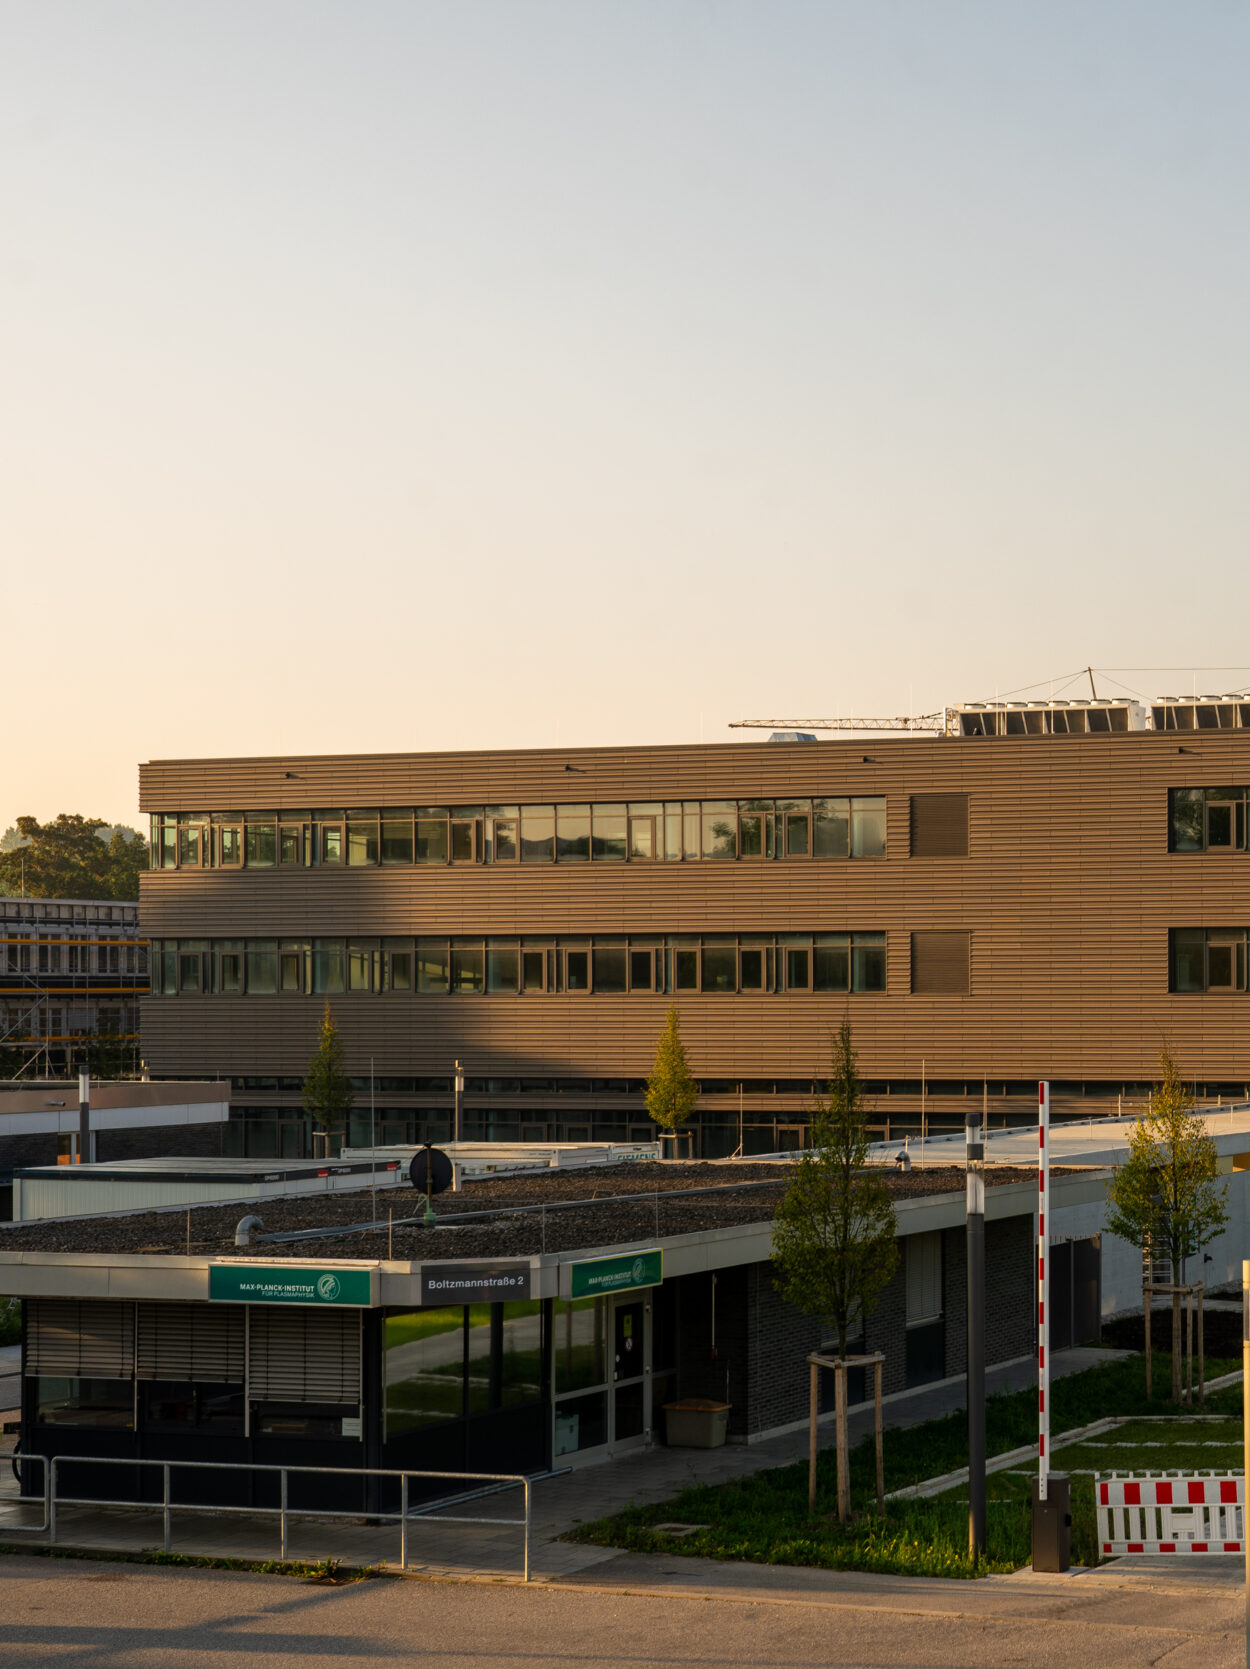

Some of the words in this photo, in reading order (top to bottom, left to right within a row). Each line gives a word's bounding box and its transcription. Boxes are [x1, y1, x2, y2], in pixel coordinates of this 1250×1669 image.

[240, 1283, 315, 1292] MAX-PLANCK-INSTITUT
[428, 1277, 516, 1289] Boltzmannstraße
[517, 1276, 524, 1285] 2
